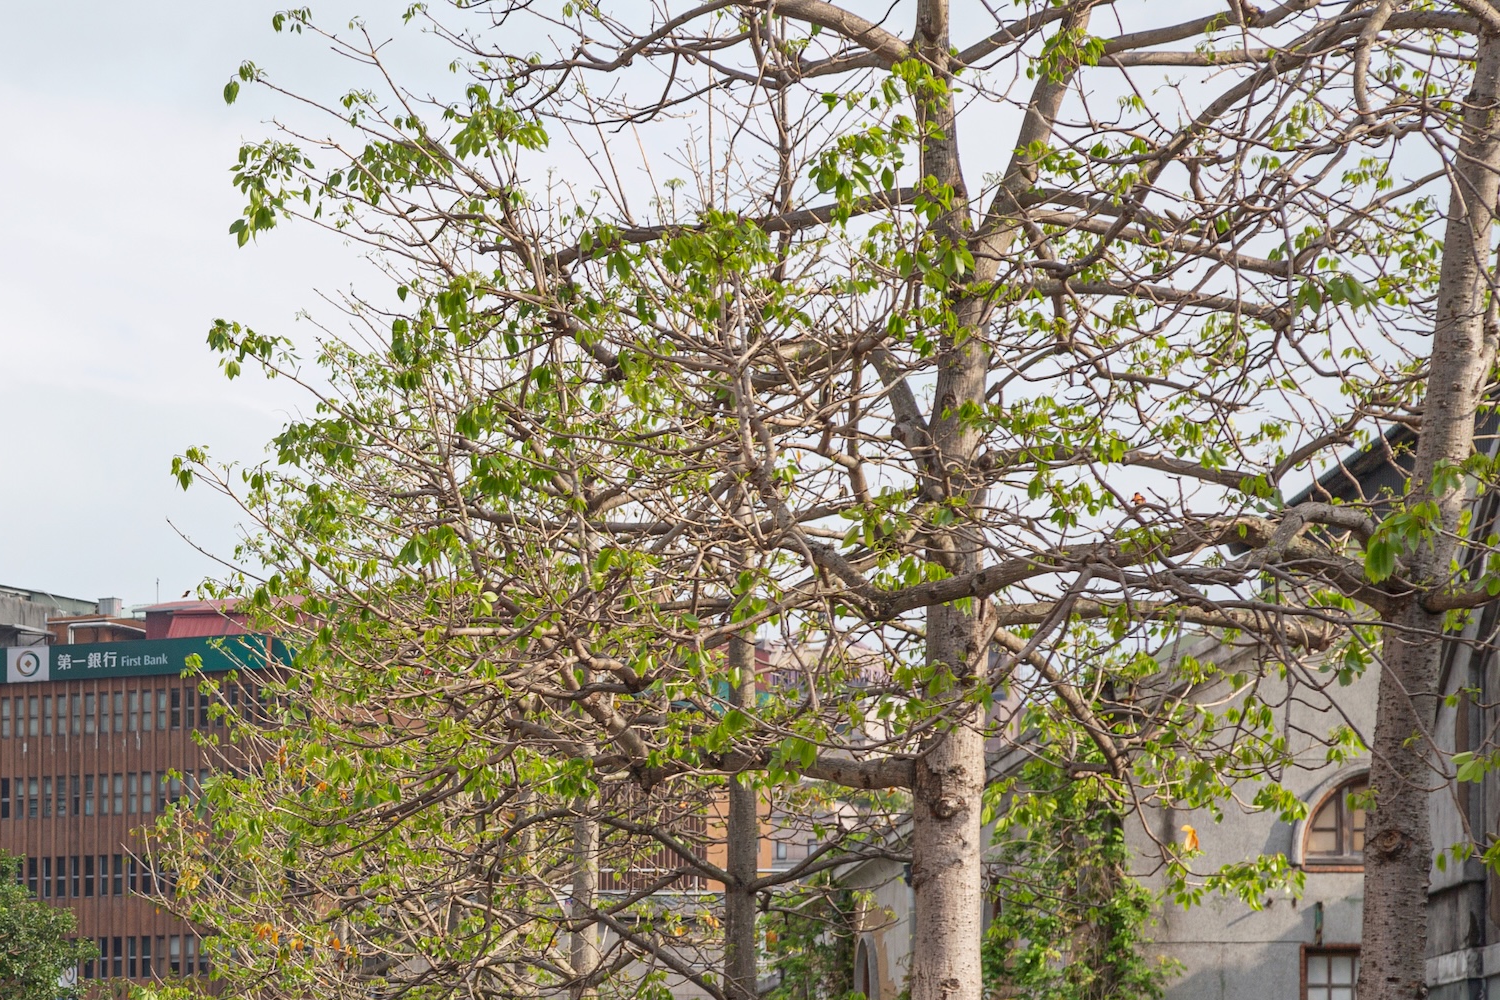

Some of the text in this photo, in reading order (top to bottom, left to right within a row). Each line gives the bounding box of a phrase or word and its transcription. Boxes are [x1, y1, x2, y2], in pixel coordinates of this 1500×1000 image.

[57, 651, 117, 670] 第一銀行
[121, 653, 168, 667] First Bank
